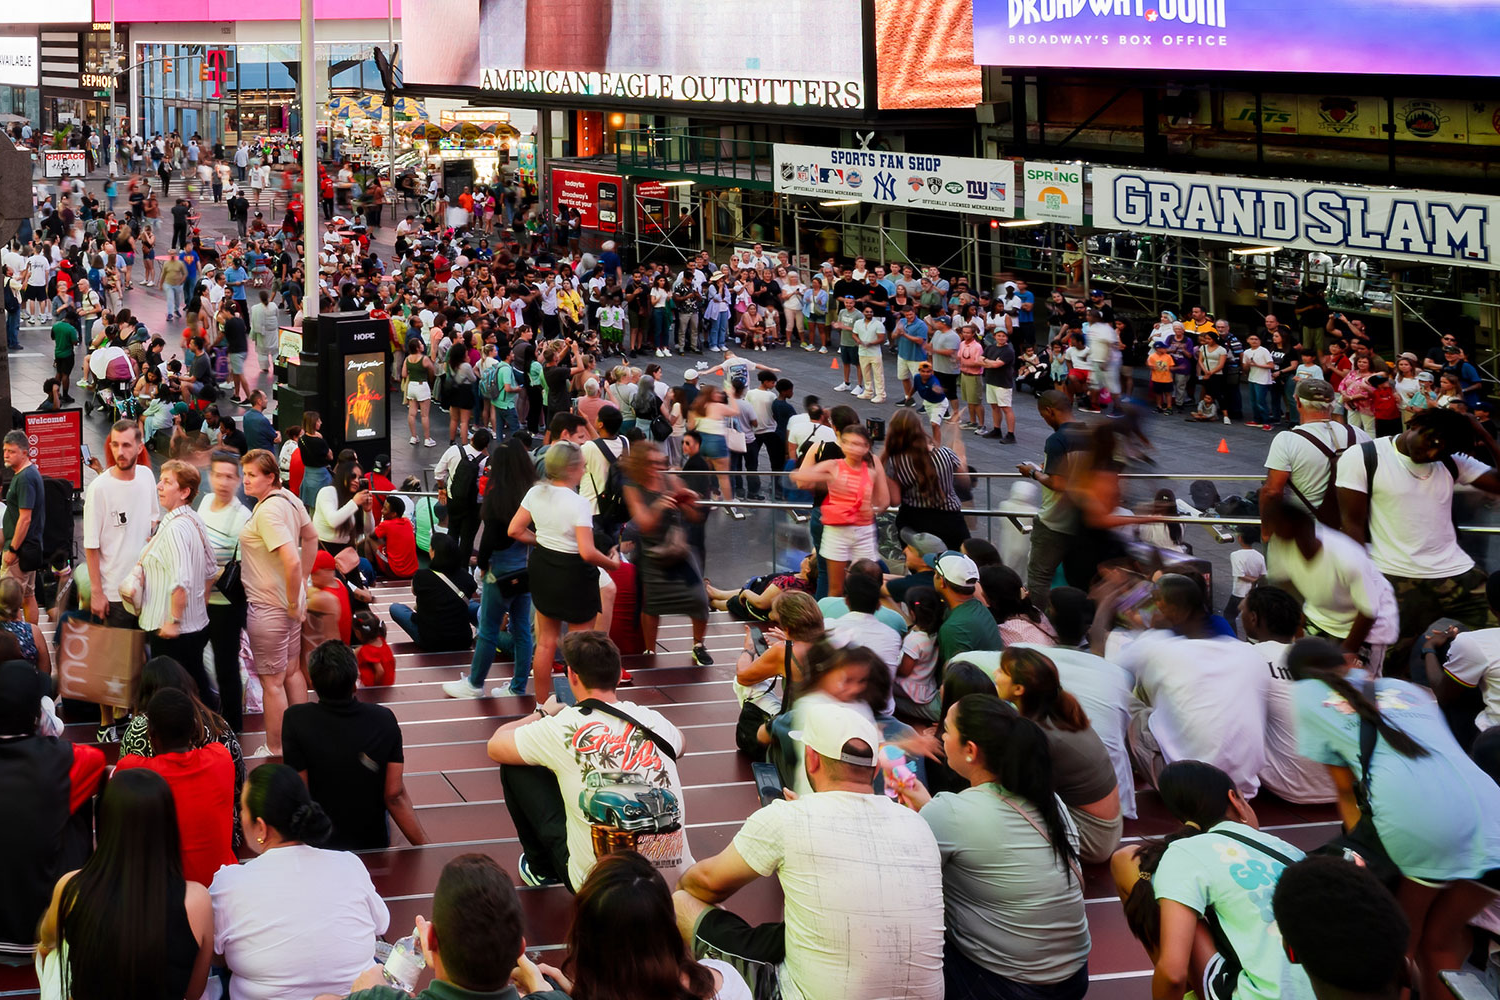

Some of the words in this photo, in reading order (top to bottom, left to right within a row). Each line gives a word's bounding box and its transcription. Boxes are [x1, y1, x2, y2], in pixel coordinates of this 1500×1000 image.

[1119, 35, 1152, 46] BOX
[1162, 35, 1228, 47] OFFICE
[482, 69, 591, 94] AMERICAN
[599, 73, 673, 98] EAGLE
[681, 77, 861, 109] OUTFITTERS
[46, 153, 85, 161] CHICAGO
[831, 150, 876, 167] SPORTS
[880, 154, 905, 170] FAN
[908, 157, 942, 172] SHOP
[835, 190, 863, 198] MERCHANDISE
[922, 199, 946, 207] OFFICIALLY
[947, 201, 970, 209] LICENSED
[971, 203, 1005, 212] MERCHANDISE
[1113, 174, 1299, 243] GRAND
[1304, 188, 1490, 263] SLAM
[27, 416, 67, 425] Welcome!
